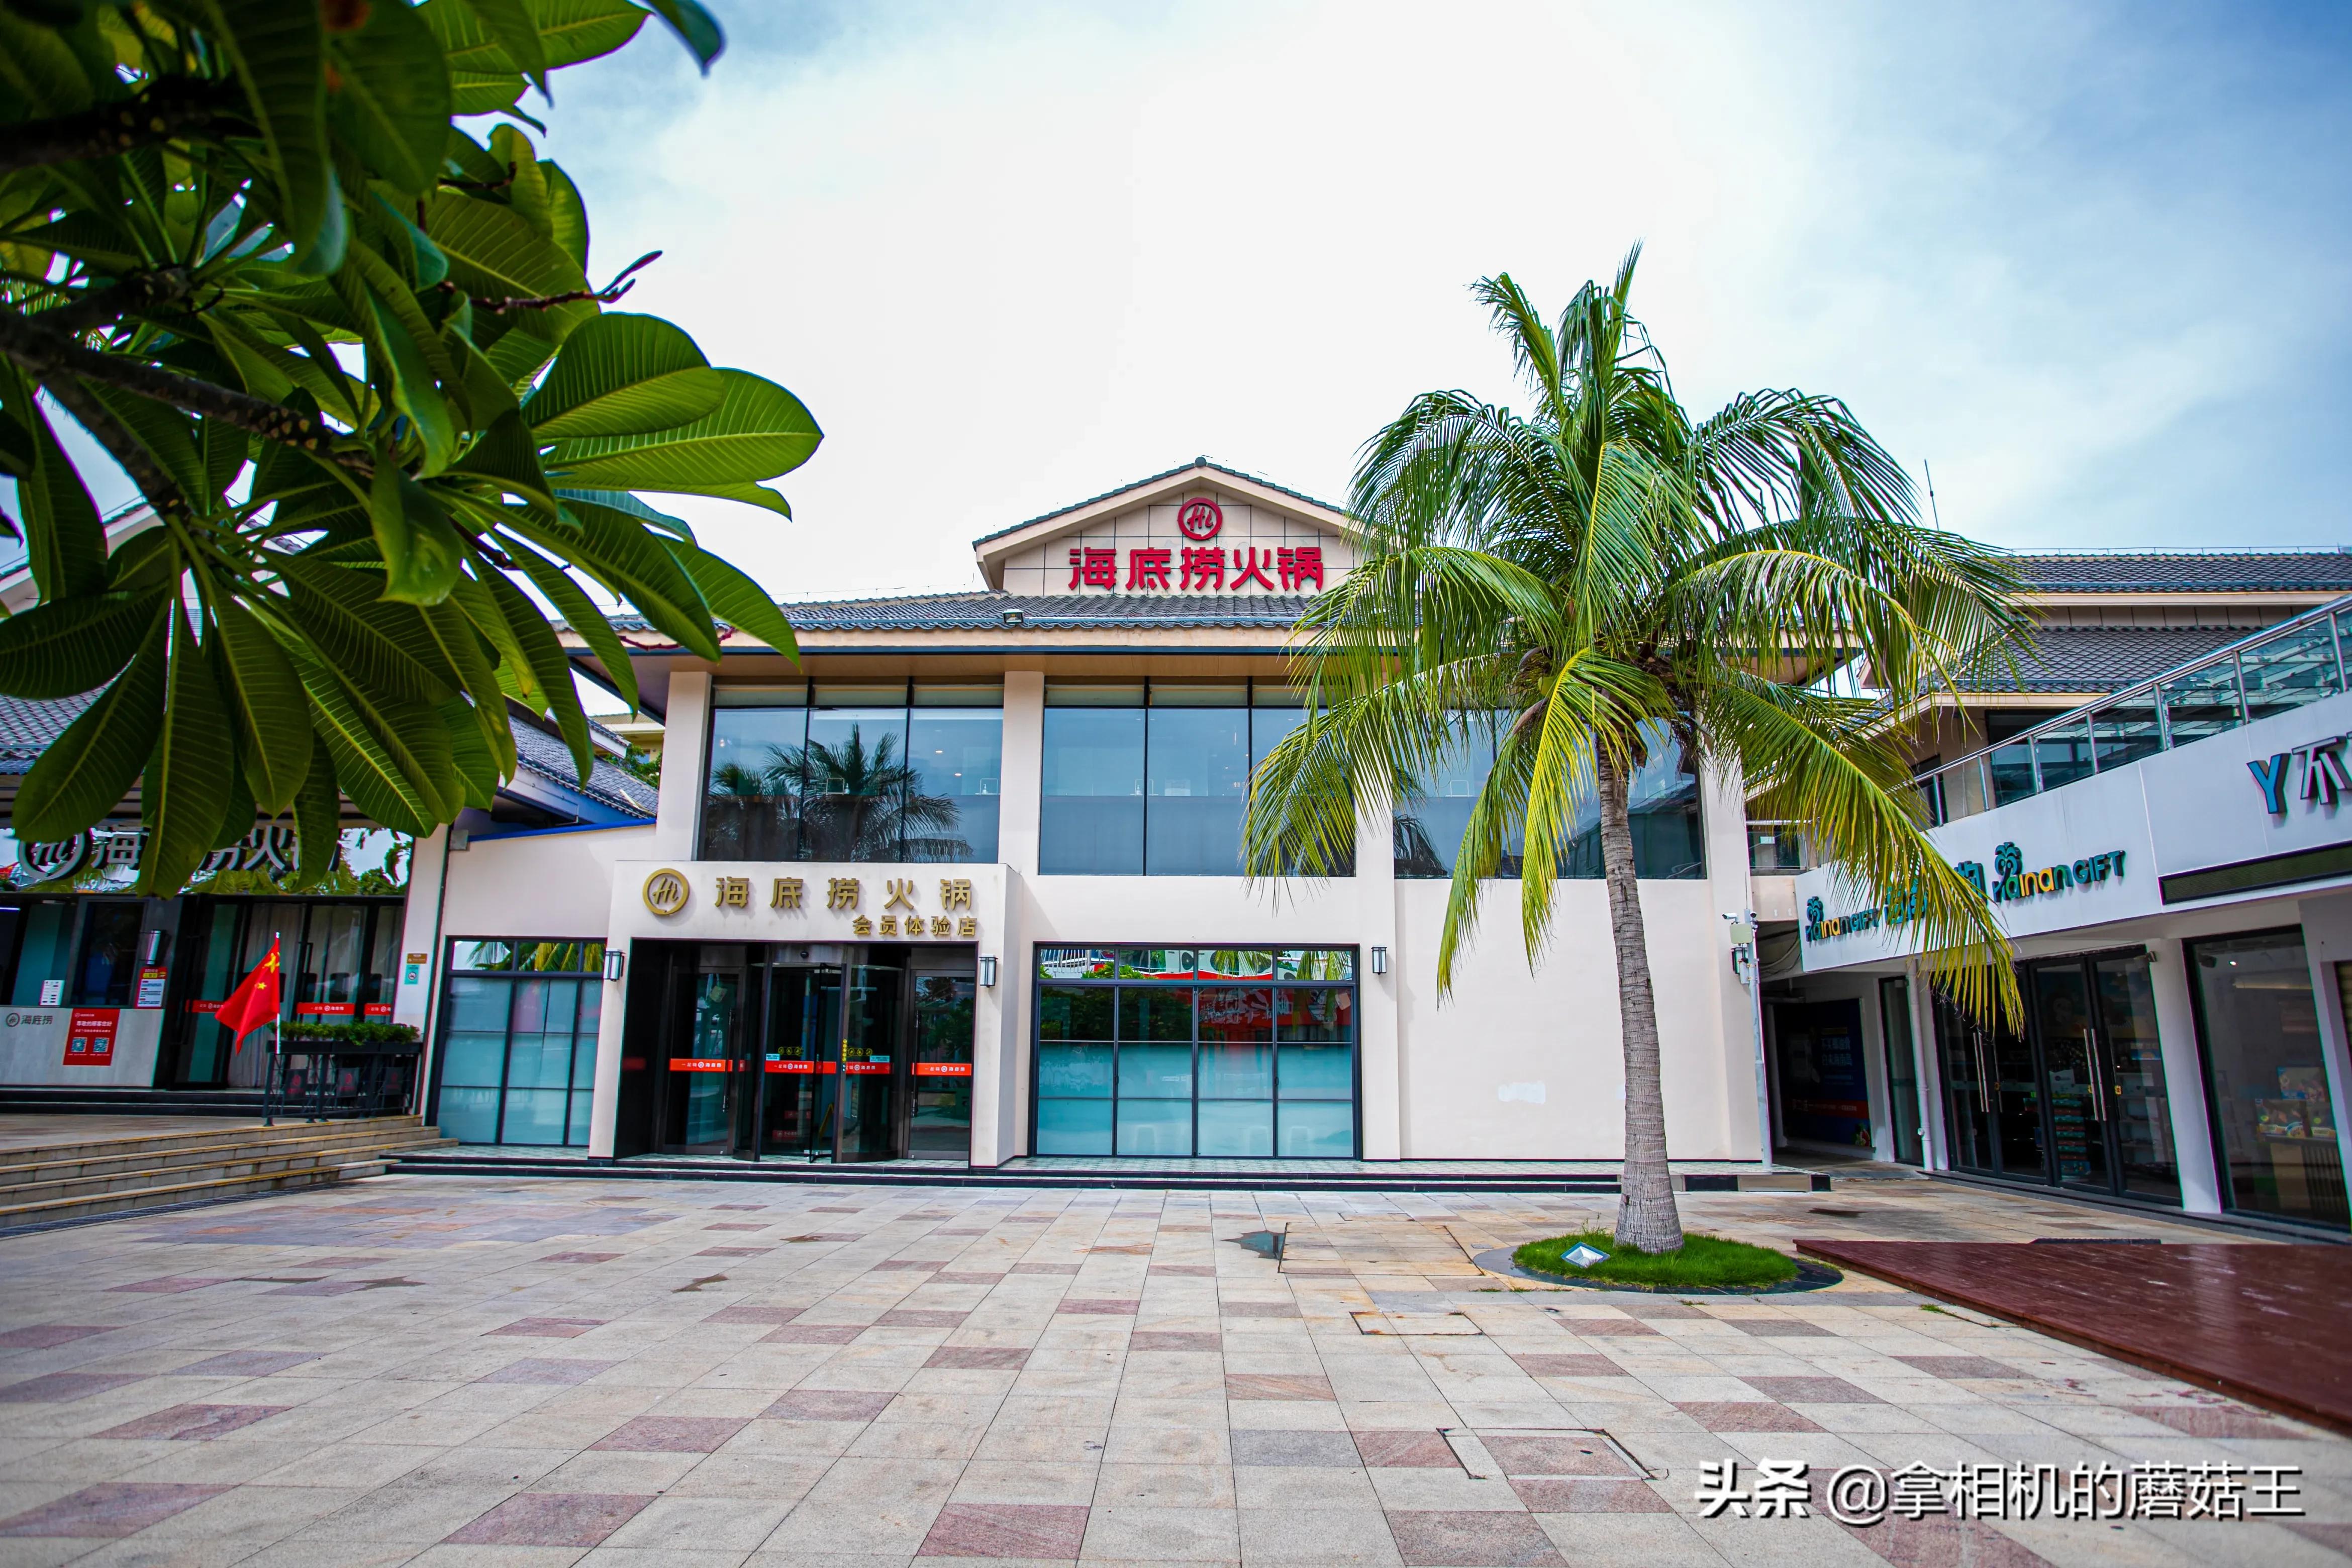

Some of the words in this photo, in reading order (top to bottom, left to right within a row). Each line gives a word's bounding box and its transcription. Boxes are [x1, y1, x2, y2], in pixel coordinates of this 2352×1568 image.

[1068, 547, 1323, 591] 海底捞火锅
[2073, 850, 2126, 884] GIFT
[715, 876, 971, 910] 海底捞火锅
[853, 915, 976, 936] 会员体验店
[21, 1015, 53, 1025] 海底捞
